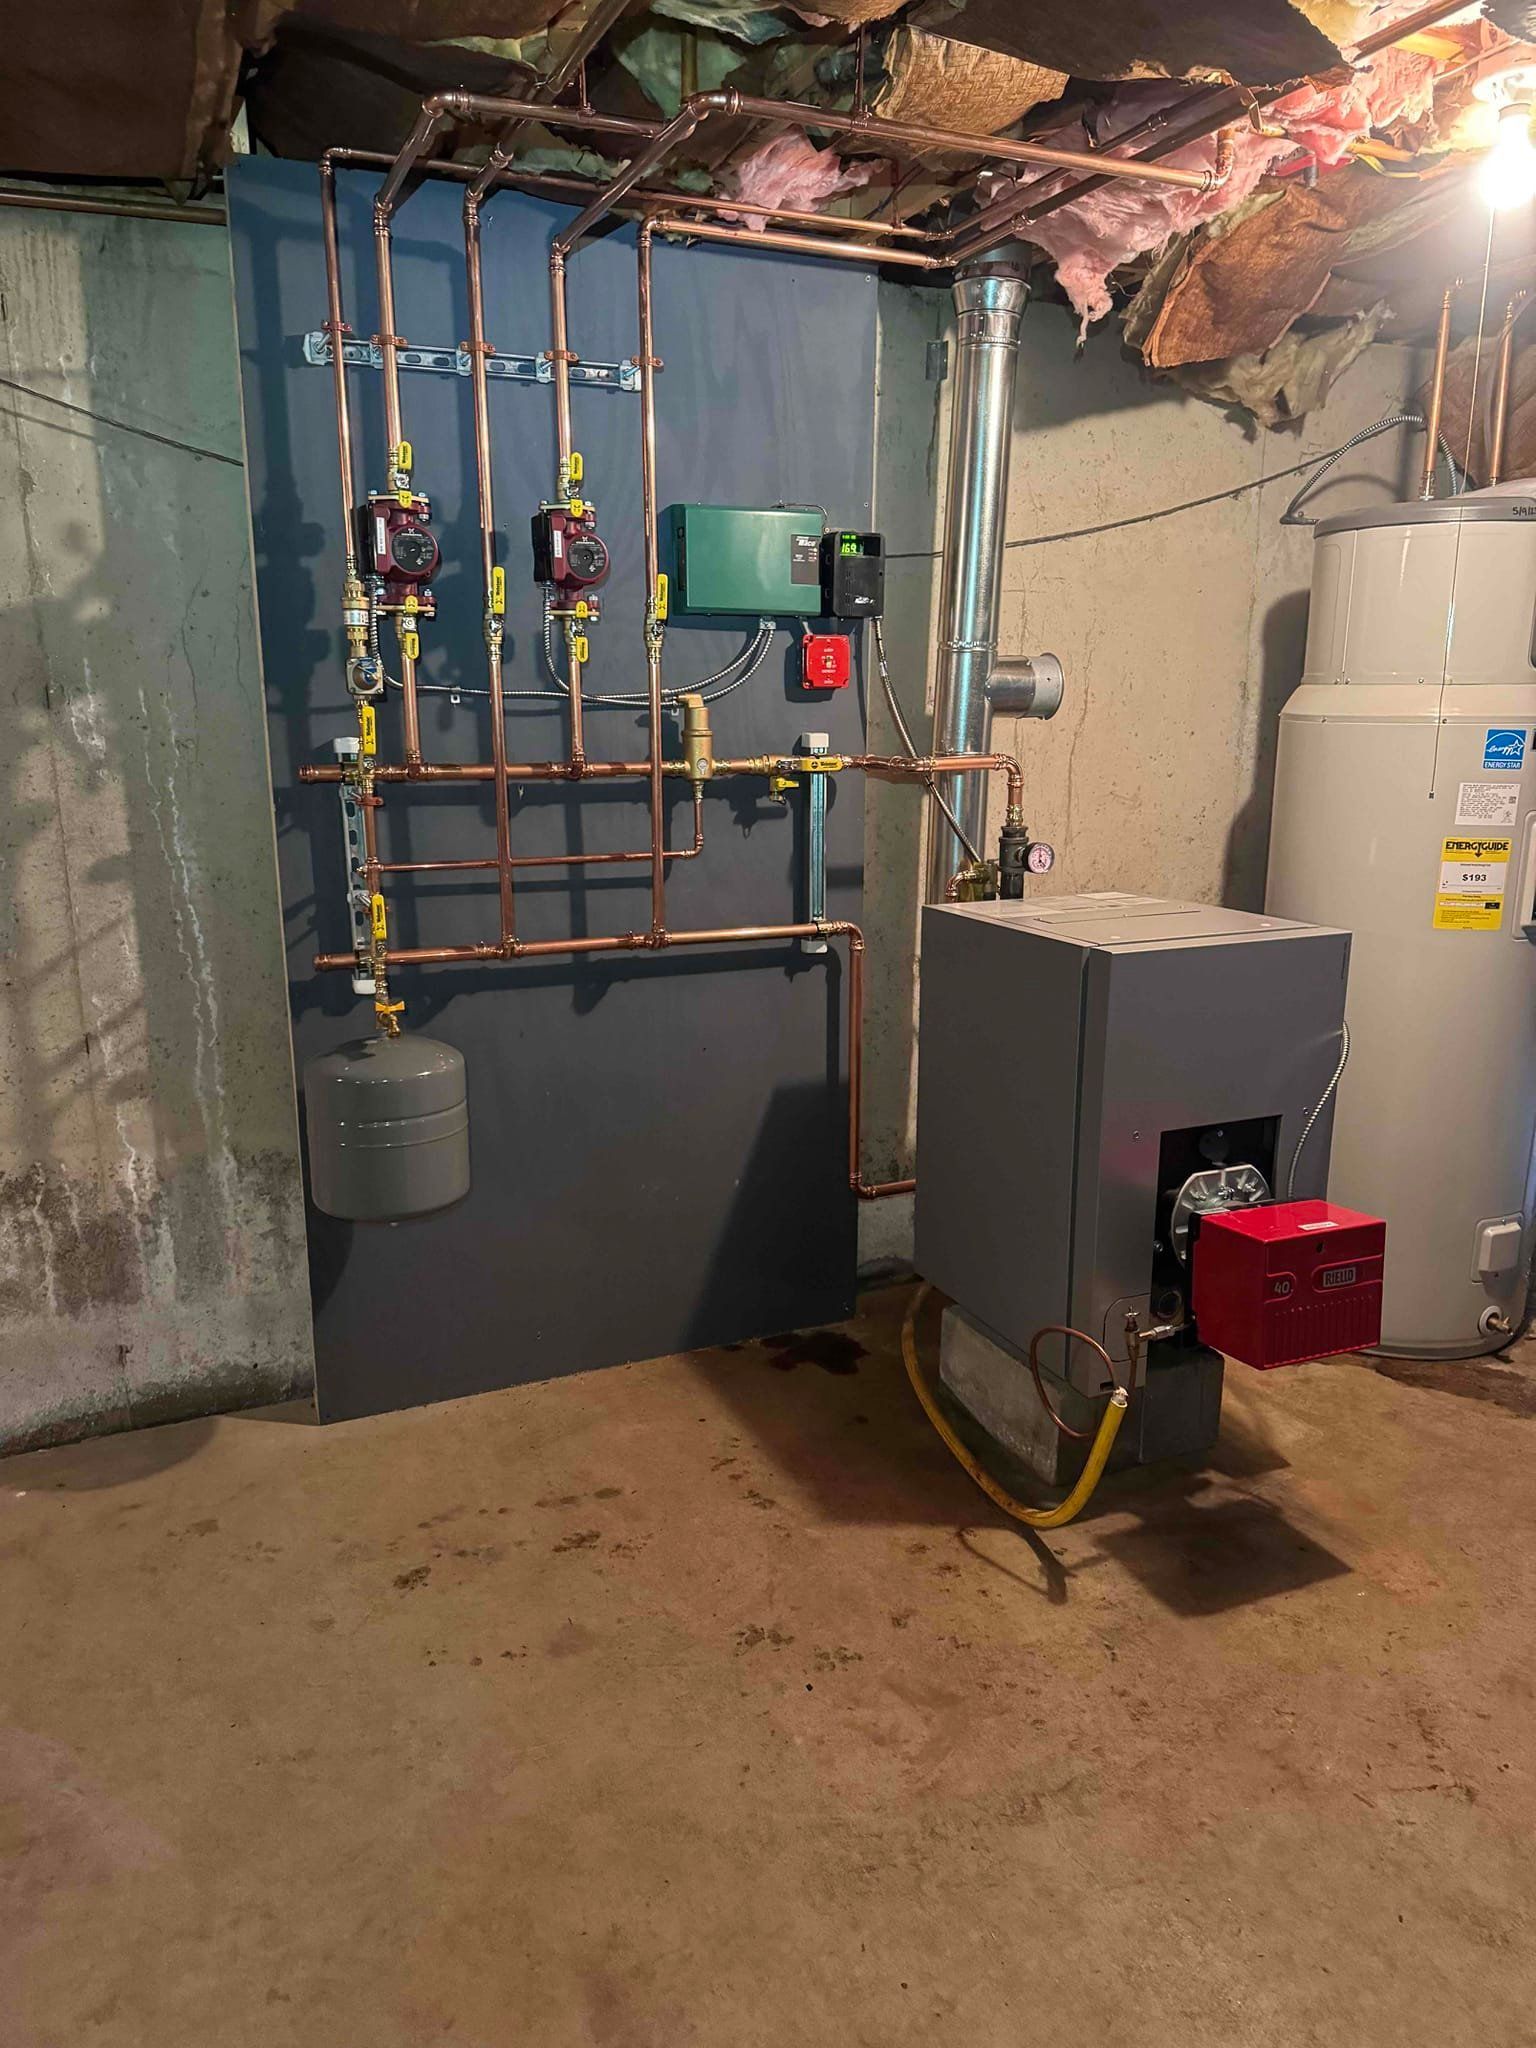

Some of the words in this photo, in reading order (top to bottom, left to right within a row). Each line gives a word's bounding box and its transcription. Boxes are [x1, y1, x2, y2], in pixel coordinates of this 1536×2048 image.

[1484, 761, 1506, 769] ENERGY
[1462, 873, 1487, 882] $193
[1325, 1269, 1354, 1286] RIELLO
[1274, 1281, 1290, 1294] 40
